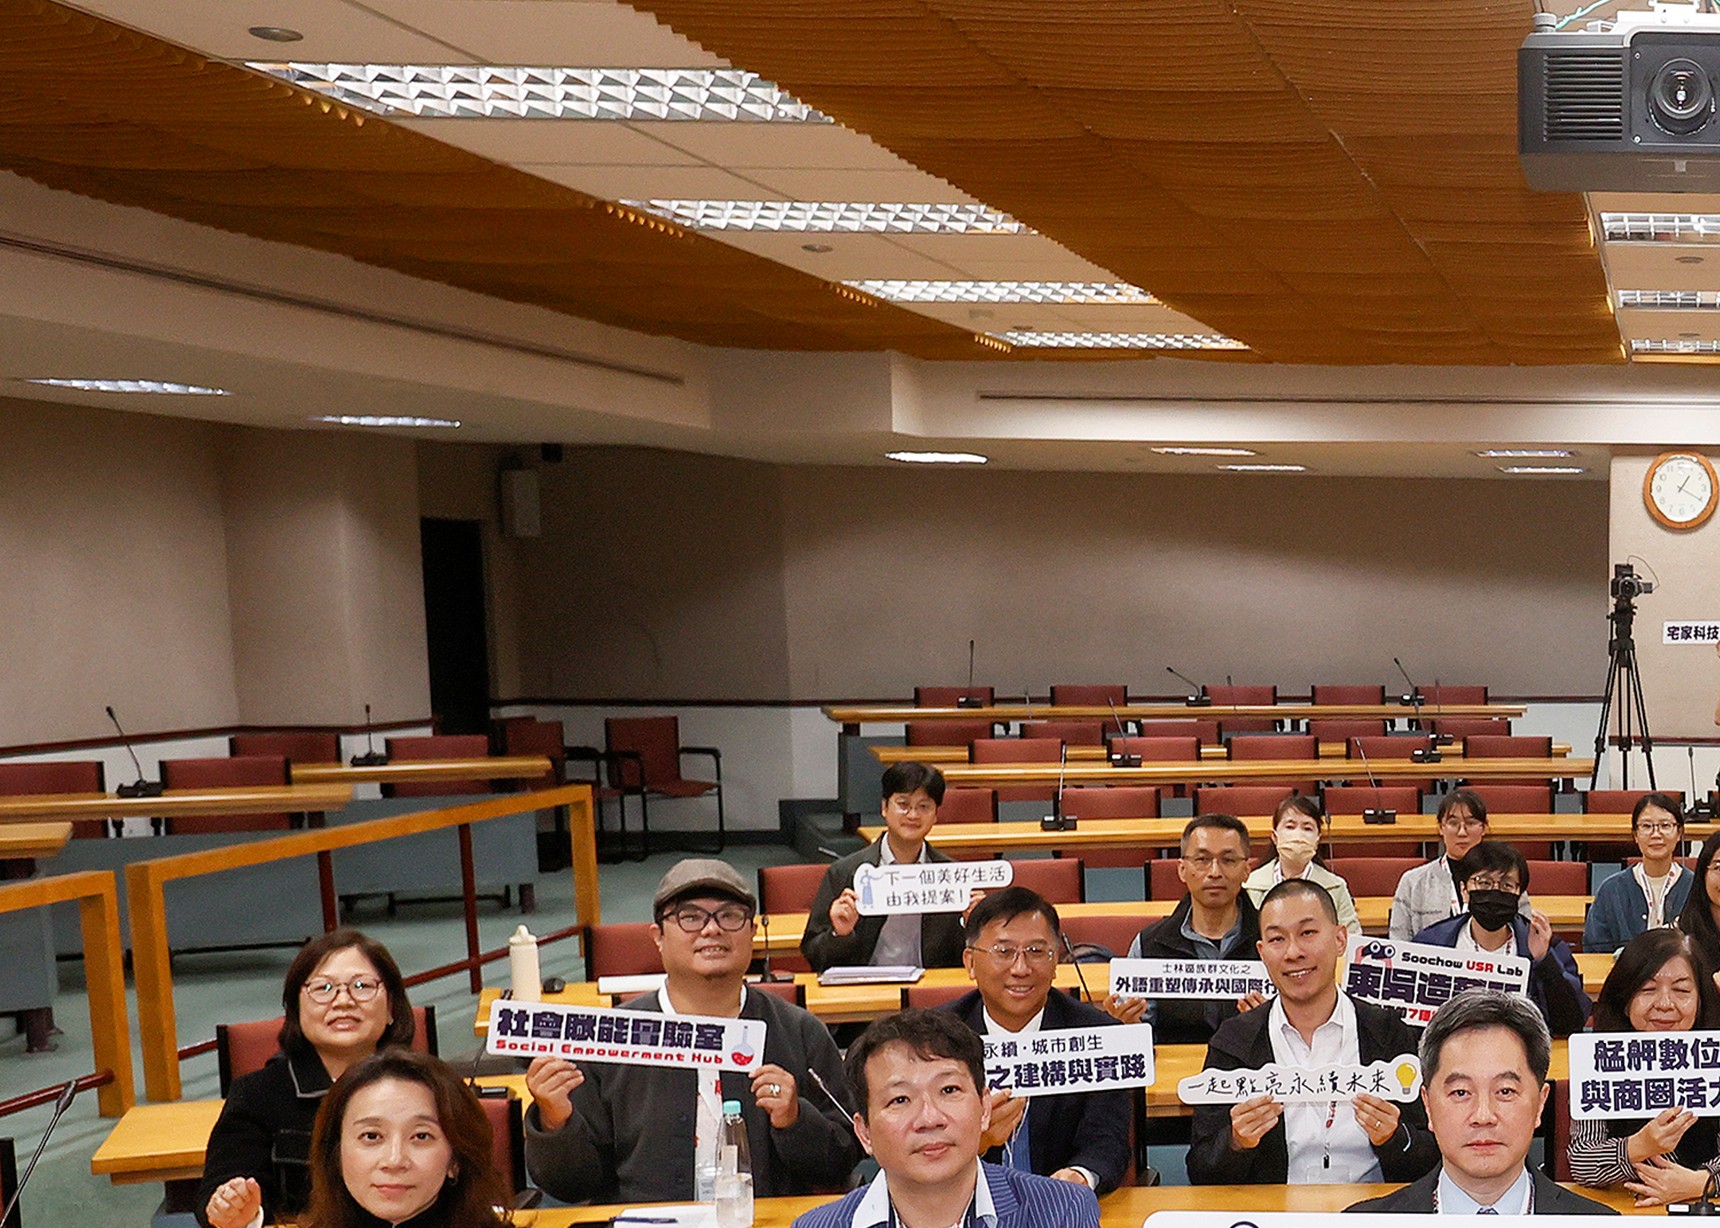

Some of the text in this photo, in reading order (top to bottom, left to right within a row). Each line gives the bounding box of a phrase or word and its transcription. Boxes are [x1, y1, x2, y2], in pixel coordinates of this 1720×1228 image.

[884, 866, 1005, 886] 下一個美好生活
[1401, 952, 1523, 977] Soochow USR Lab
[498, 1008, 725, 1051] 社會賦能實驗室
[495, 1039, 723, 1064] Social Empowerment Hub
[986, 1053, 1146, 1091] 之建構與實踐
[1188, 1071, 1391, 1098] 一起點亮永續未來
